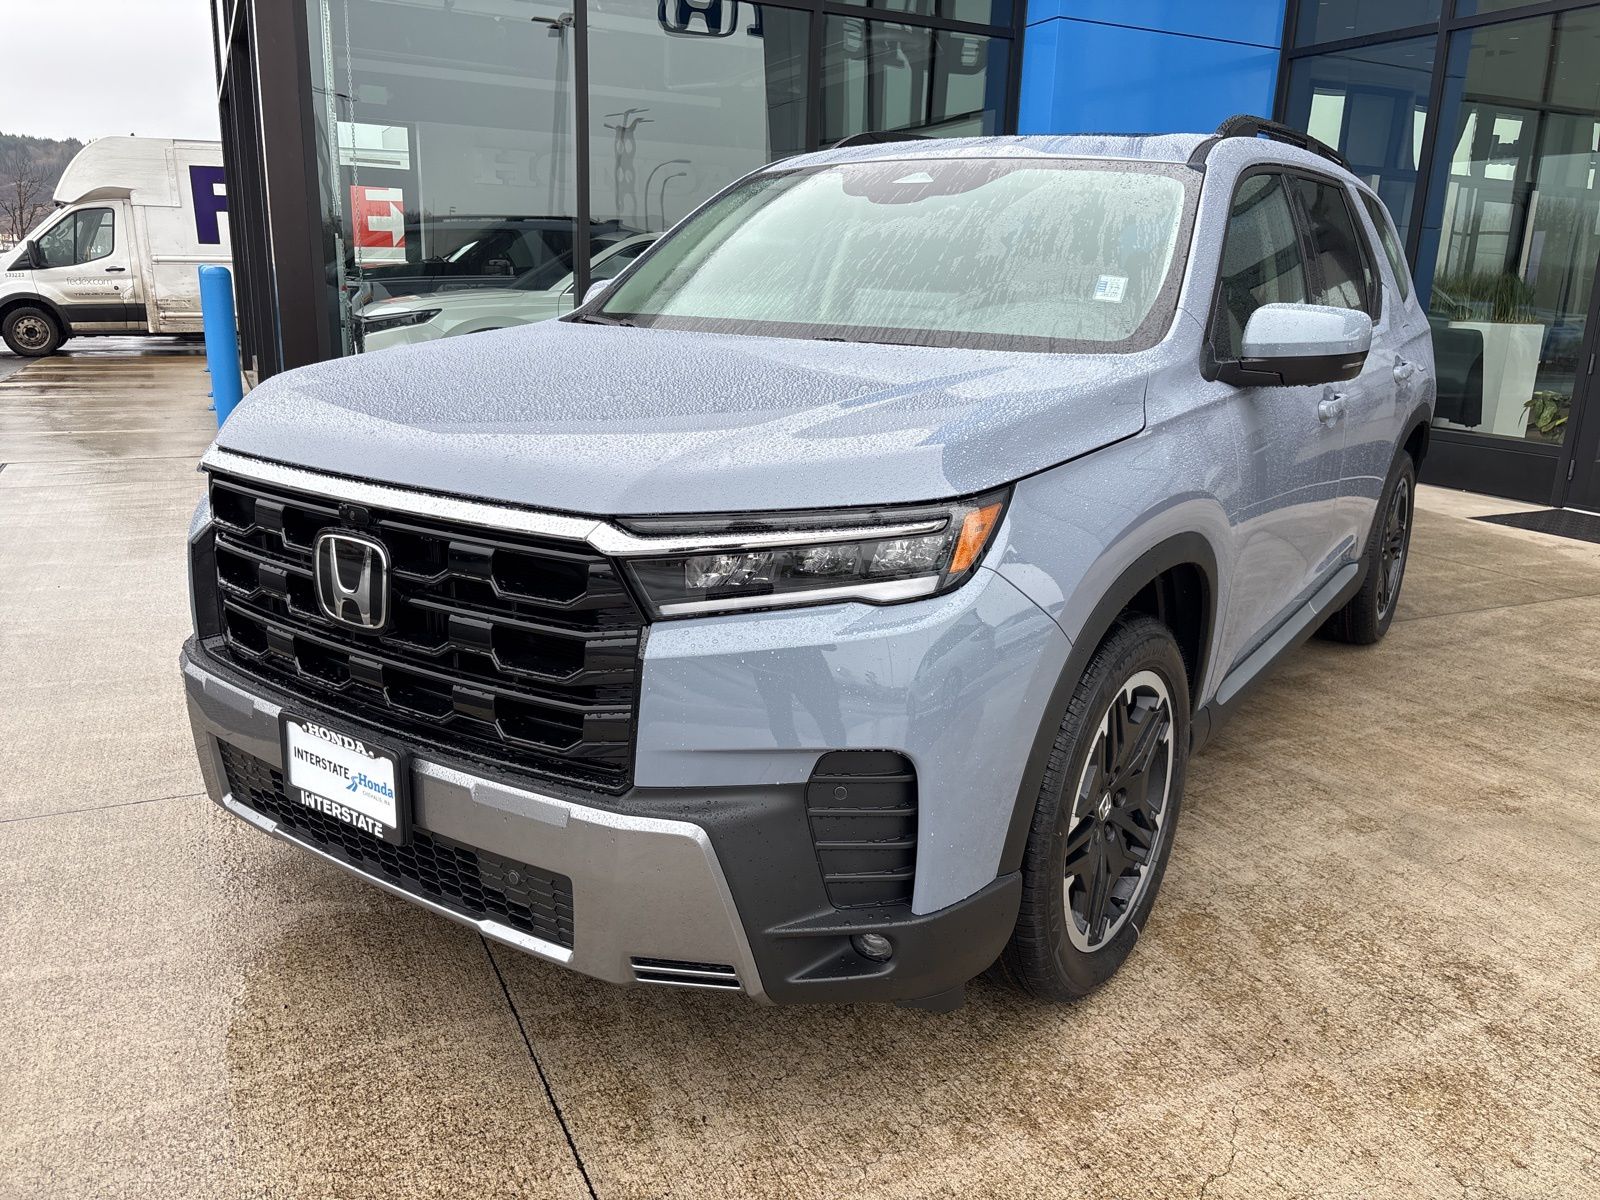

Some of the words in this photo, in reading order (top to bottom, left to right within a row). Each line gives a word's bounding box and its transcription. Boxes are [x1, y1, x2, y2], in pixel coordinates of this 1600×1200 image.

[305, 721, 369, 756] HONDA
[293, 746, 351, 780] INTERSTATE
[357, 772, 394, 799] Honda
[300, 790, 384, 839] INTERSTATE
